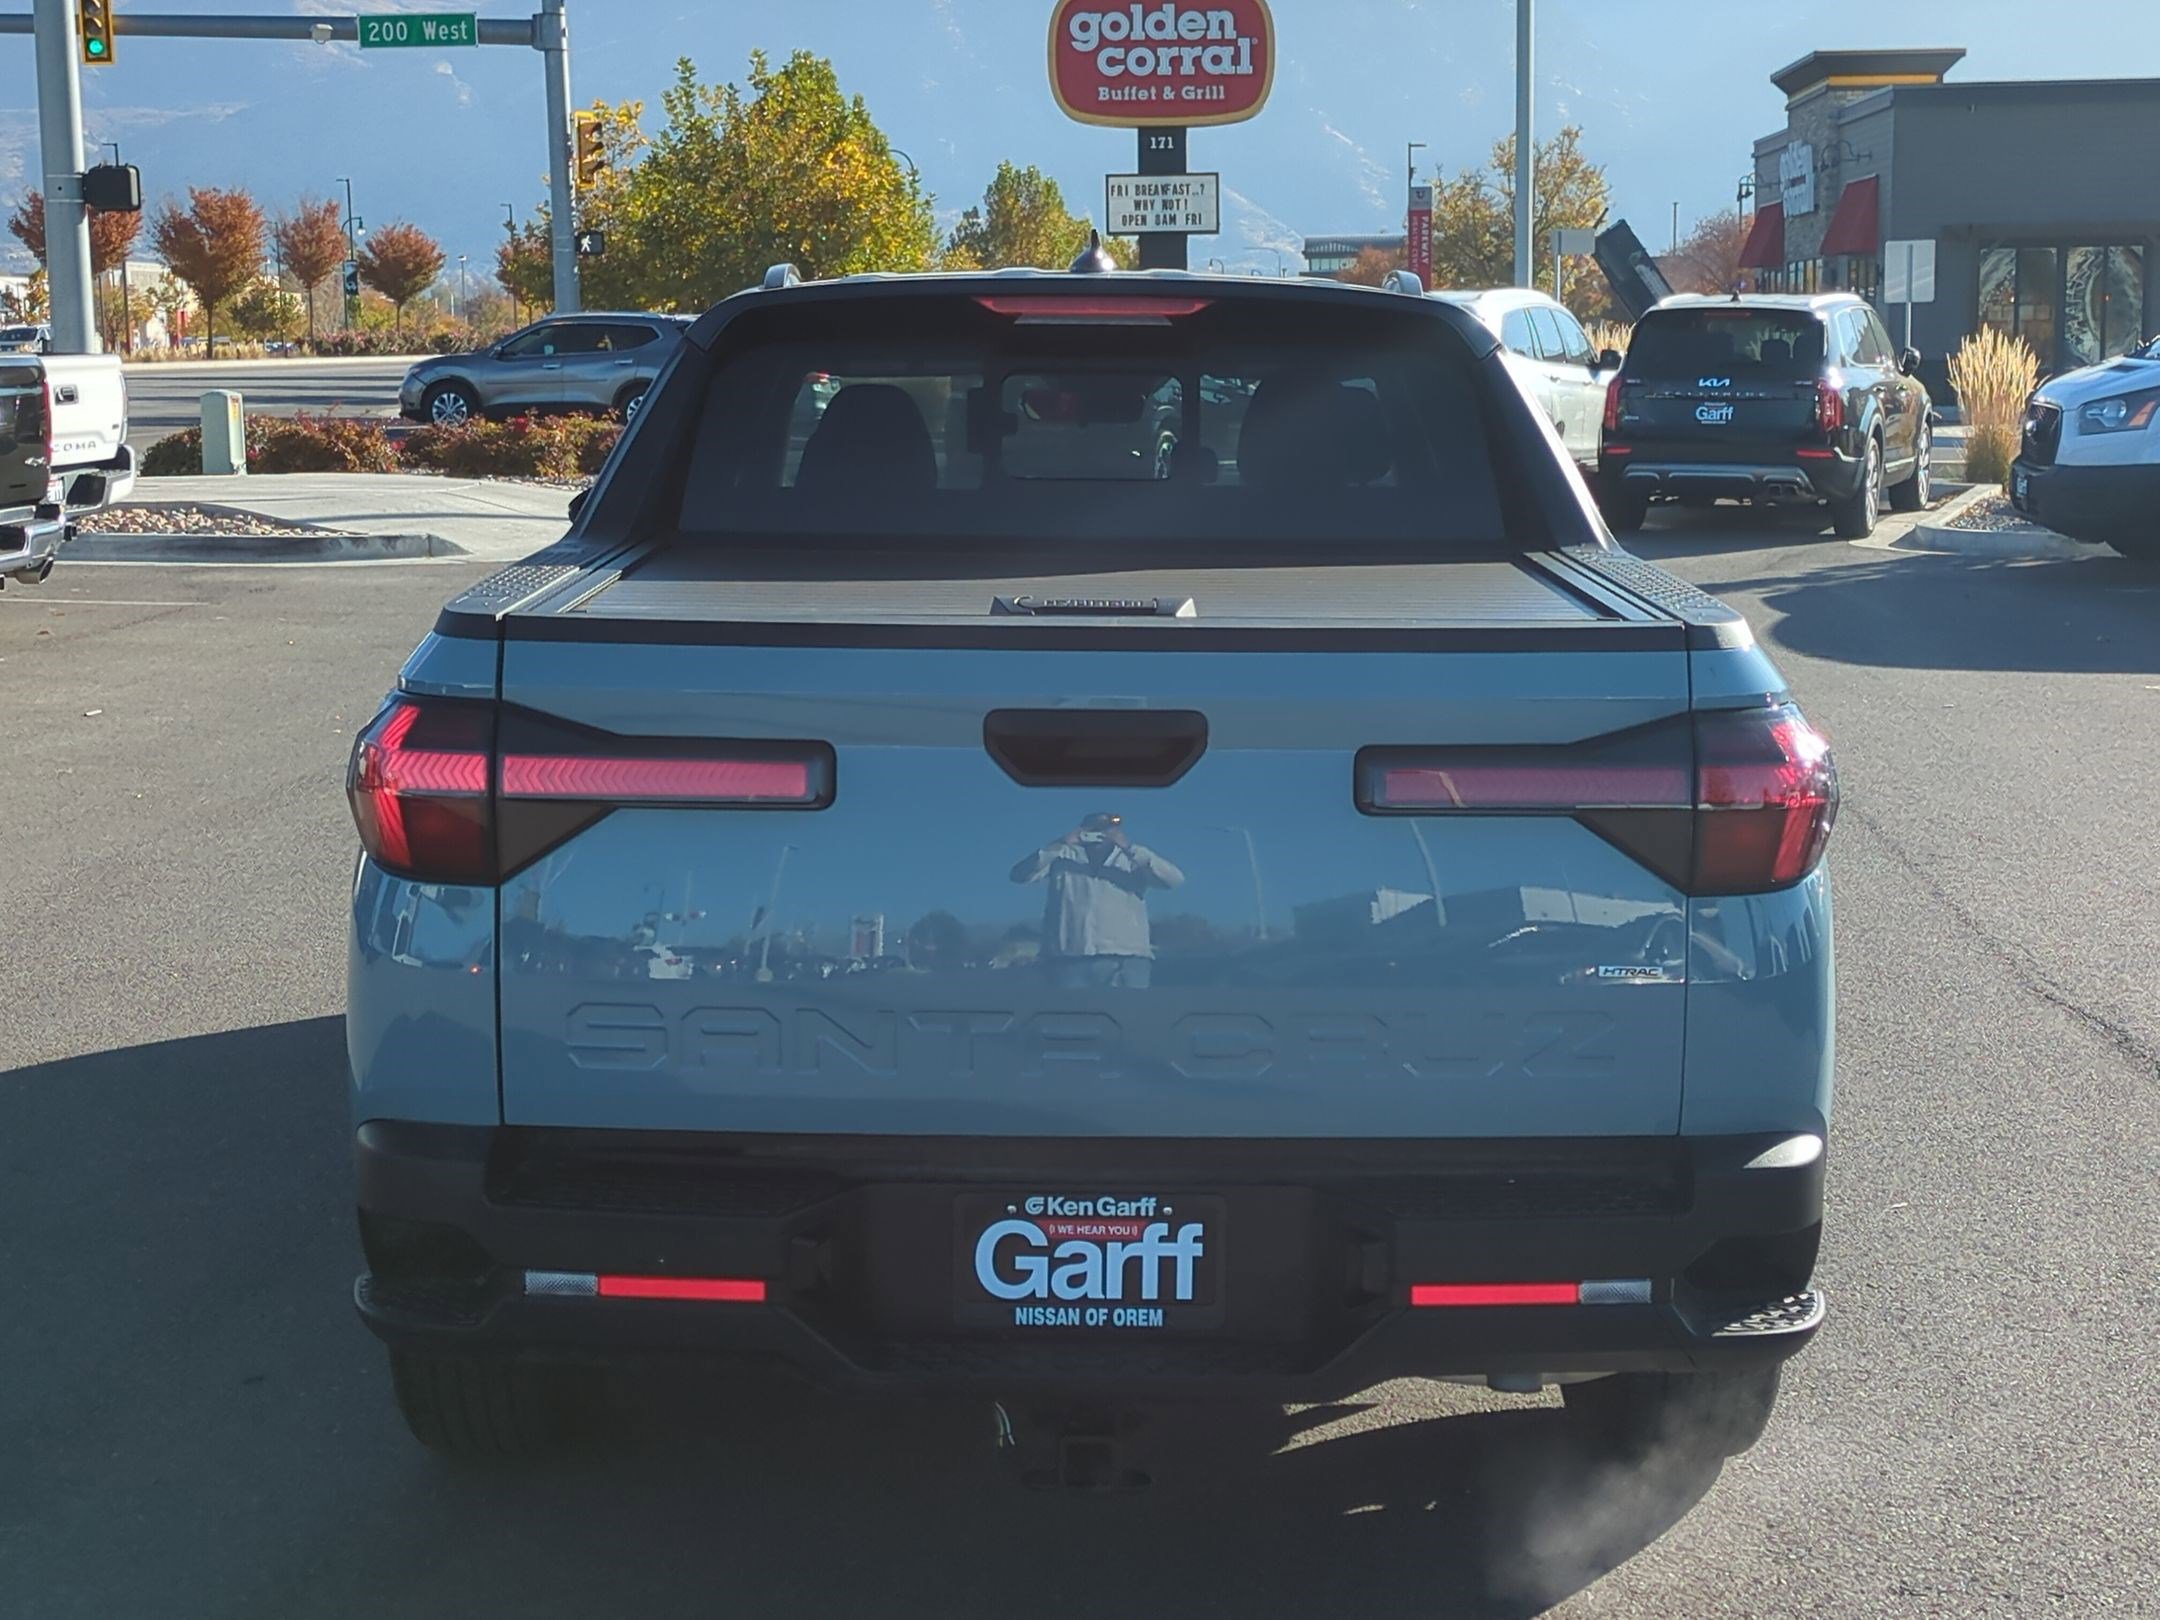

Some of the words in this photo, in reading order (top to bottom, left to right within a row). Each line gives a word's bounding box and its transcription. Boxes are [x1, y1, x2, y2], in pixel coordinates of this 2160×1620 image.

[368, 21, 408, 41] 200
[422, 20, 468, 41] West
[1069, 3, 1237, 52] golden
[1097, 37, 1253, 77] corral
[1098, 86, 1157, 101] Buffet
[1163, 86, 1175, 99] &
[1181, 85, 1225, 100] Grill
[1150, 136, 1174, 149] 171
[1110, 184, 1129, 197] FRI
[1134, 199, 1155, 211] WHY
[1121, 214, 1147, 226] OPEN
[1185, 213, 1202, 226] FRI
[1421, 215, 1429, 265] PARKWAY
[1695, 405, 1734, 421] Garff
[51, 440, 97, 453] COMA
[1602, 966, 1660, 977] HTRAC
[565, 1001, 1123, 1081] SANTA
[1169, 1009, 1617, 1081] CRUZ
[1047, 1196, 1093, 1216] Ken
[1097, 1196, 1157, 1217] Garff
[1057, 1224, 1074, 1235] WE
[1077, 1225, 1106, 1235] HEAR
[1107, 1225, 1131, 1236] YOU
[975, 1218, 1204, 1300] Garff
[1015, 1307, 1080, 1326] NISSAN
[1085, 1308, 1108, 1326] OF
[1113, 1308, 1164, 1327] OREM
